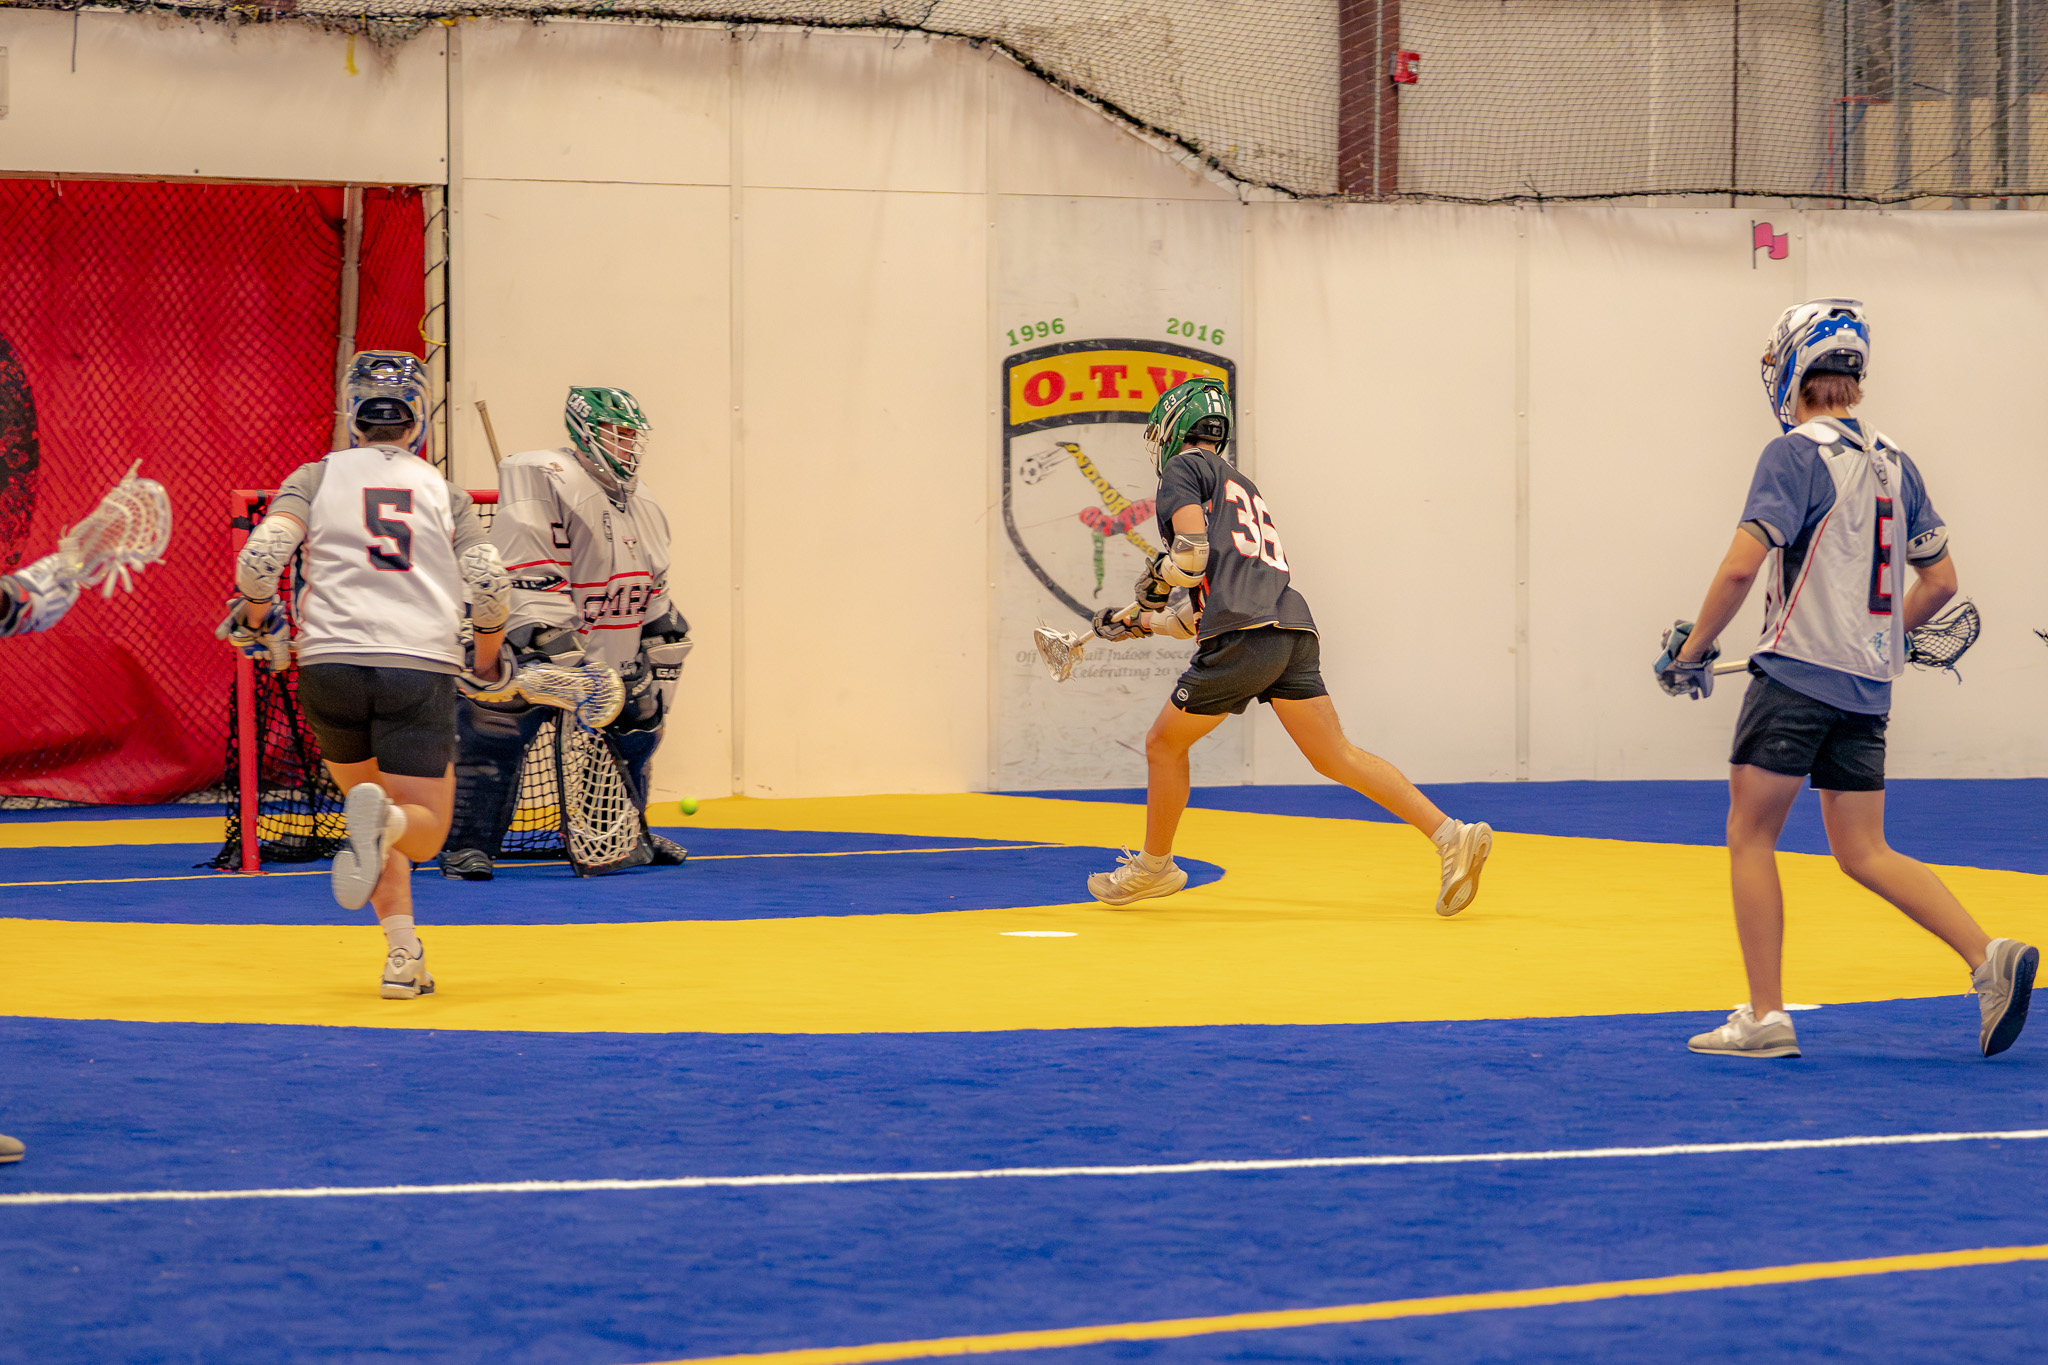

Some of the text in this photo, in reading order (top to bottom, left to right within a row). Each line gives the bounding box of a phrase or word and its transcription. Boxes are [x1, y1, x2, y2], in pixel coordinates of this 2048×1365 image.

[1006, 317, 1066, 347] 1996
[1166, 317, 1226, 346] 2016
[567, 393, 593, 419] CATS
[1163, 394, 1177, 412] 23
[362, 486, 414, 572] 5
[1224, 478, 1290, 573] 36
[1914, 529, 1939, 549] STX
[1107, 647, 1150, 665] Indoor
[1072, 664, 1151, 681] Celebrating
[1154, 667, 1171, 677] 20
